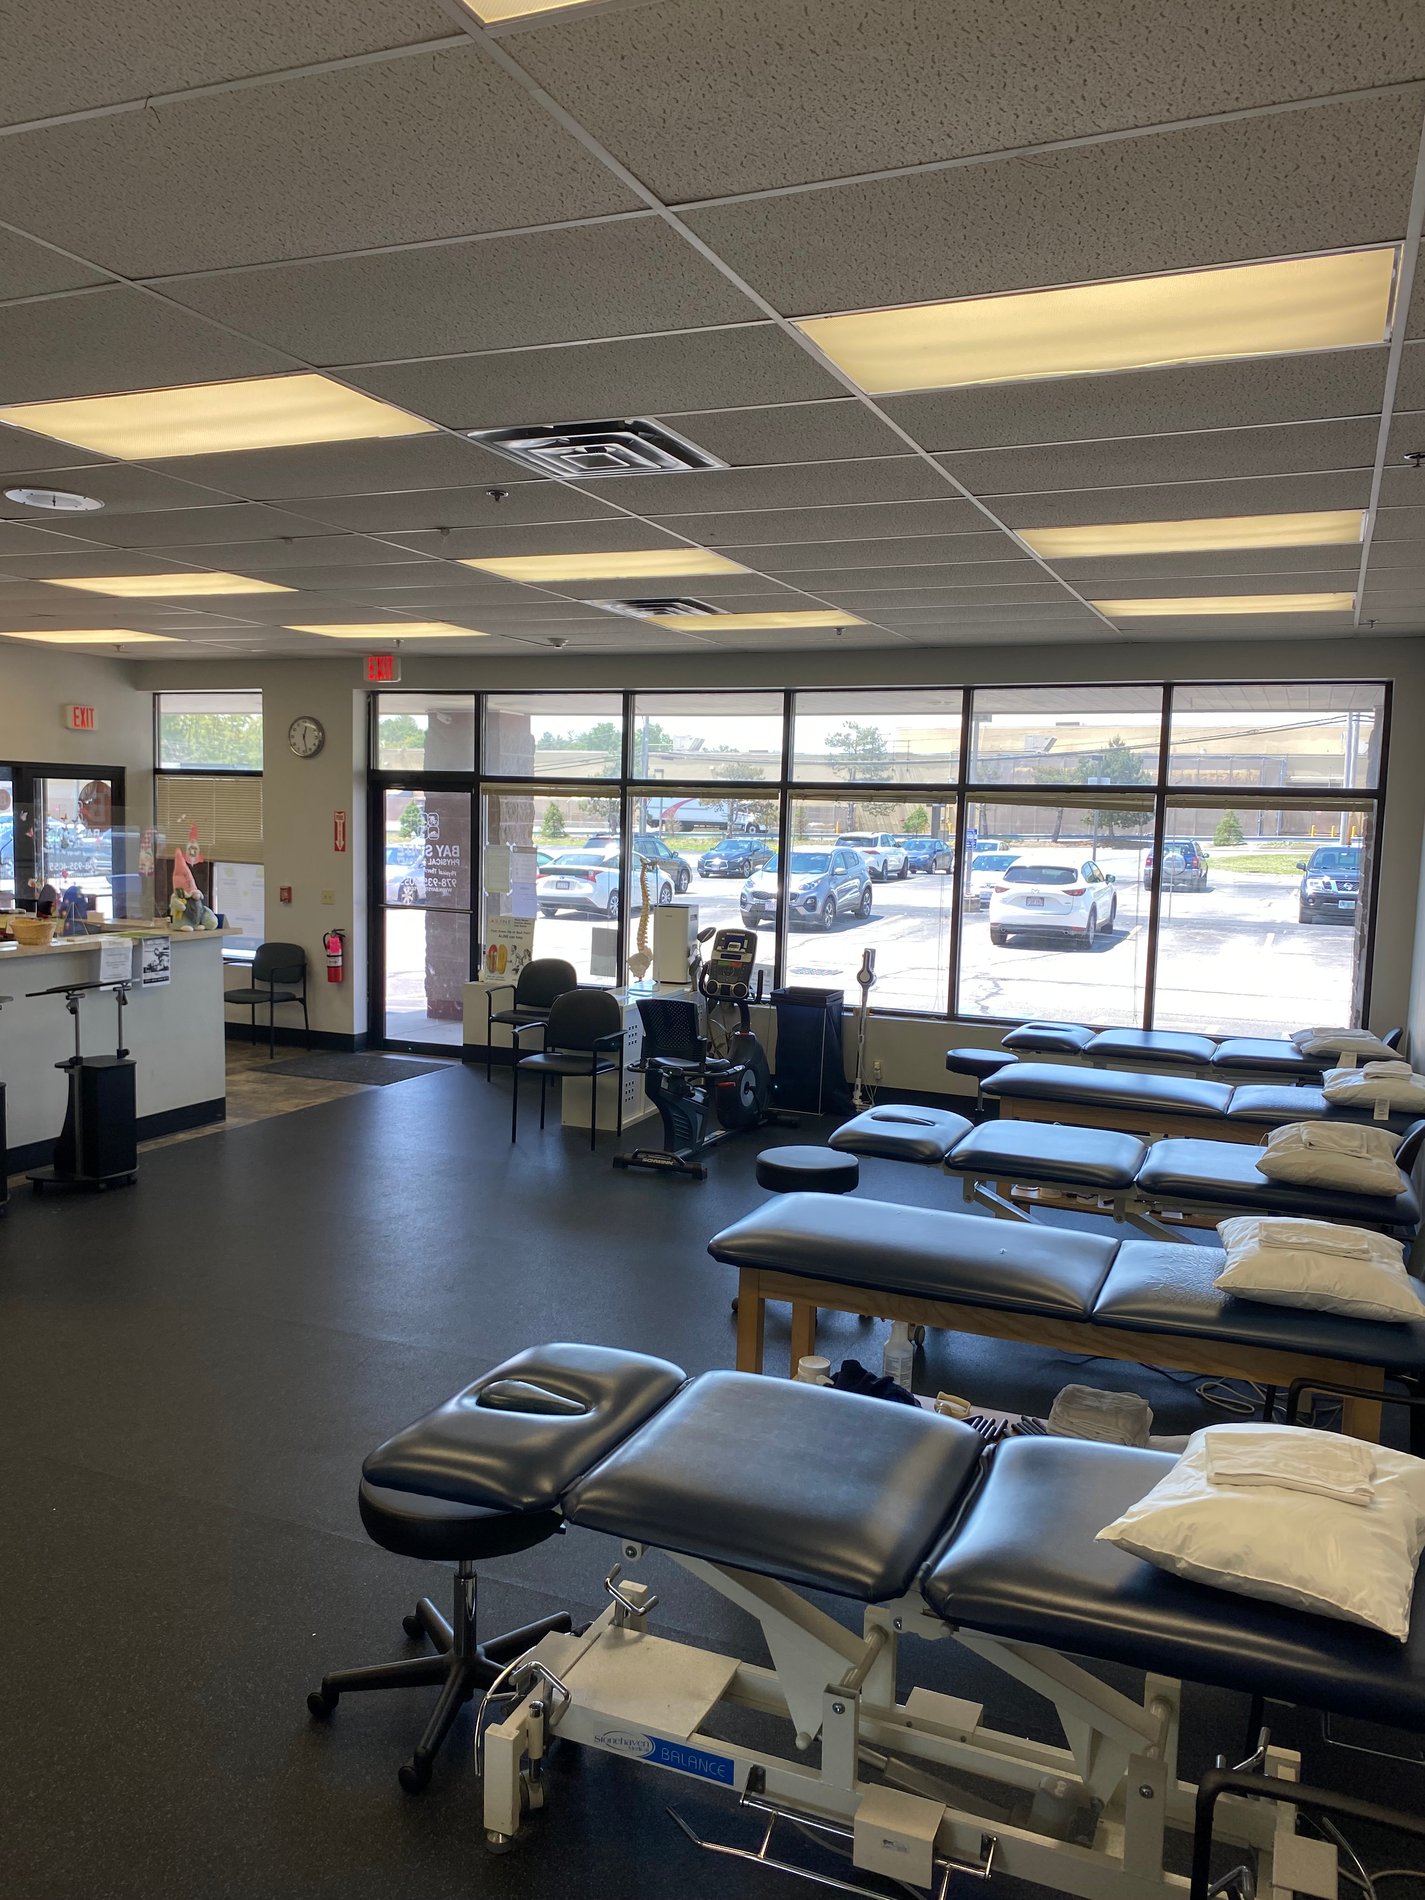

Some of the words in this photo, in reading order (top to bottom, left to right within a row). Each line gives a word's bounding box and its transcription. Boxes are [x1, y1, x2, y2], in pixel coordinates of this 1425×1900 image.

[368, 655, 393, 680] EXIT
[73, 706, 94, 728] EXIT
[594, 1735, 650, 1748] Stonehaven
[661, 1747, 727, 1778] BALANCE
